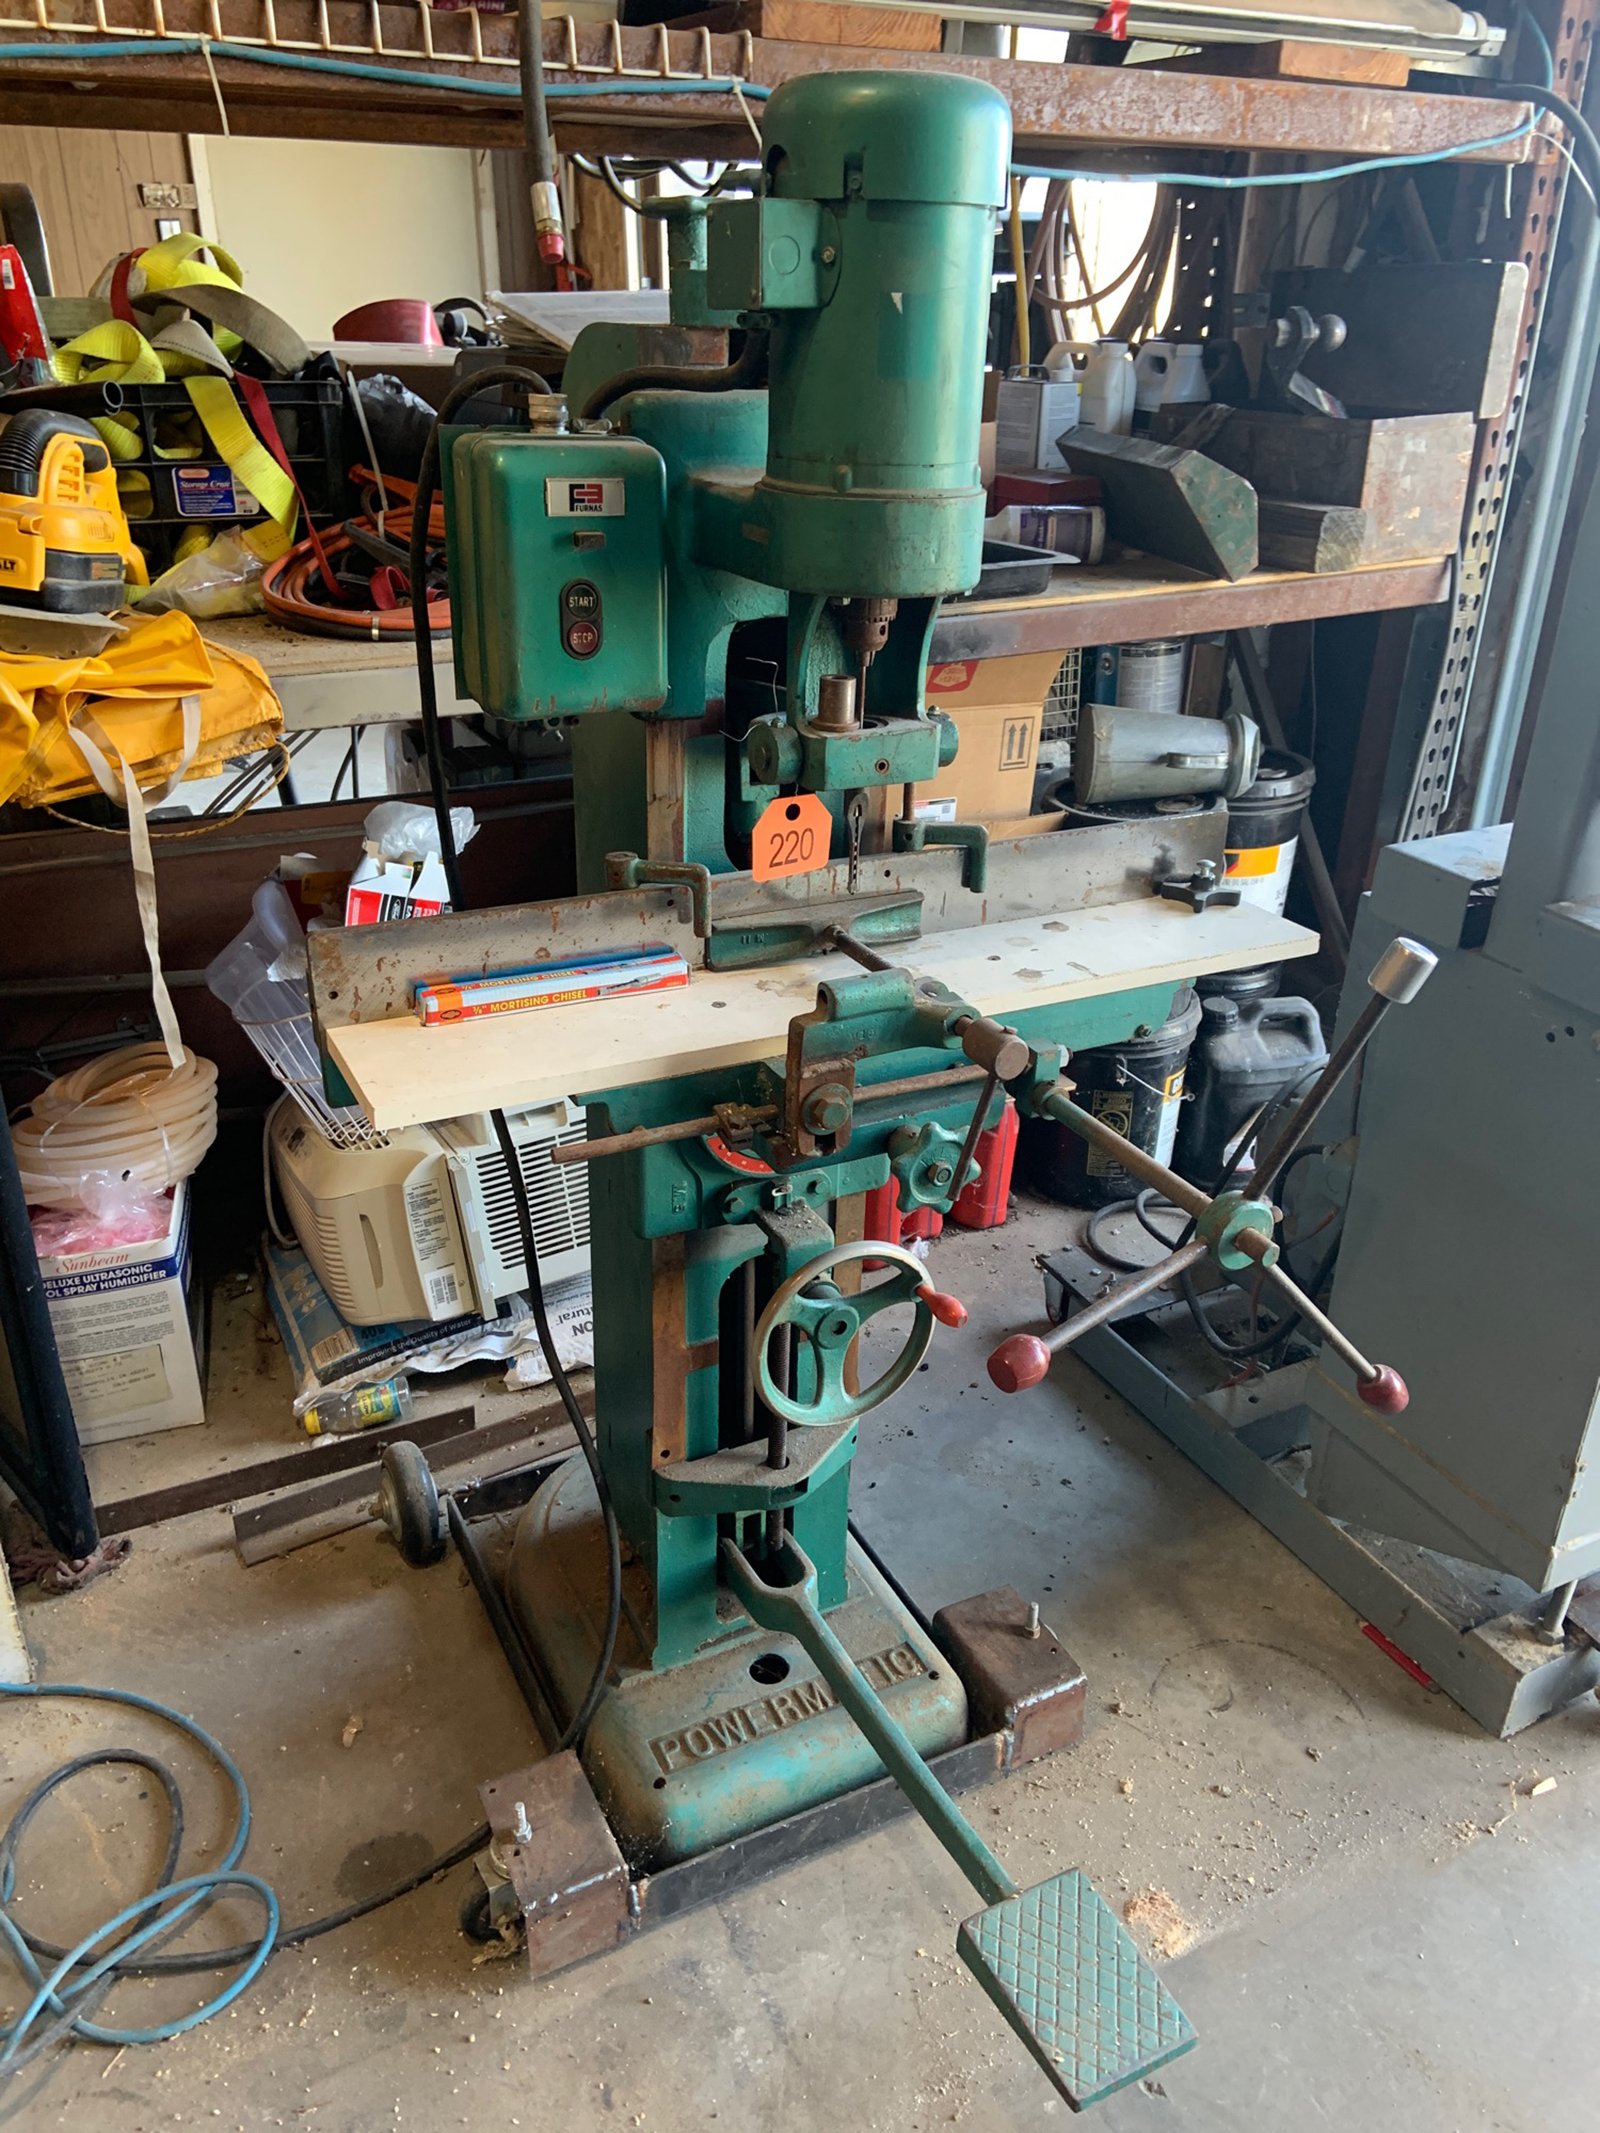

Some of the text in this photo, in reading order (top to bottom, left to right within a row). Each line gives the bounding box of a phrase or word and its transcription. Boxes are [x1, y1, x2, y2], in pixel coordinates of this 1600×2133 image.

[575, 504, 603, 512] FURNAS
[569, 596, 593, 608] START
[769, 827, 814, 868] 220
[479, 975, 539, 988] MORTISING
[541, 970, 577, 980] CHISEL
[490, 995, 549, 1013] MORTISING
[552, 989, 587, 1003] CHISEL
[56, 1253, 129, 1275] Sunbeam
[82, 1264, 153, 1284] ULTRASONIC
[63, 1282, 97, 1296] SPRAY
[100, 1269, 167, 1290] HUMIDIFIER
[358, 1345, 398, 1364] Improving
[410, 1329, 439, 1346] Quality
[449, 1319, 472, 1331] Water
[658, 1647, 922, 1770] POWERMTIC
